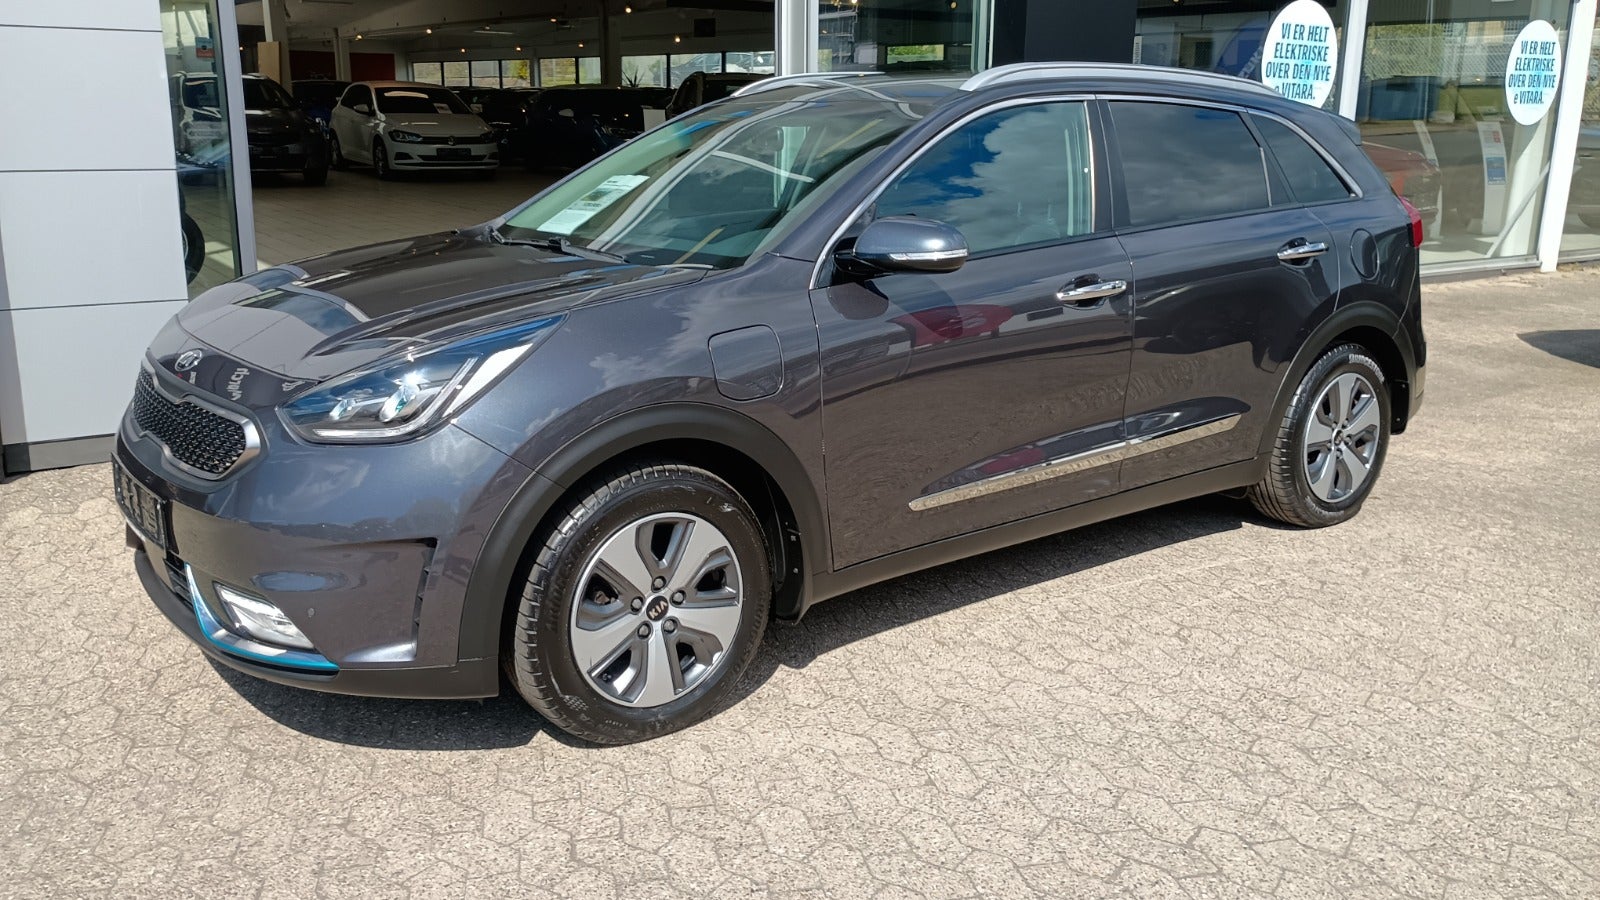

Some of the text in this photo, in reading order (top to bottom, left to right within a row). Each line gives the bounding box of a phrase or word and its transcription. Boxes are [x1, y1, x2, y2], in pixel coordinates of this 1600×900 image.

[1281, 22, 1330, 43] VI ER HELT
[1273, 42, 1330, 62] ELEKTRISKE
[1520, 41, 1556, 55] VI ER HELT
[1265, 61, 1290, 79] OVER
[1292, 63, 1312, 80] DEN
[1313, 65, 1332, 81] NYE
[1514, 57, 1556, 72] ELEKTRISKE
[1508, 74, 1557, 88] OVER DEN NYE
[1281, 82, 1316, 100] VITARA.
[1513, 90, 1544, 104] e VITARA.
[648, 600, 668, 619] KIA
